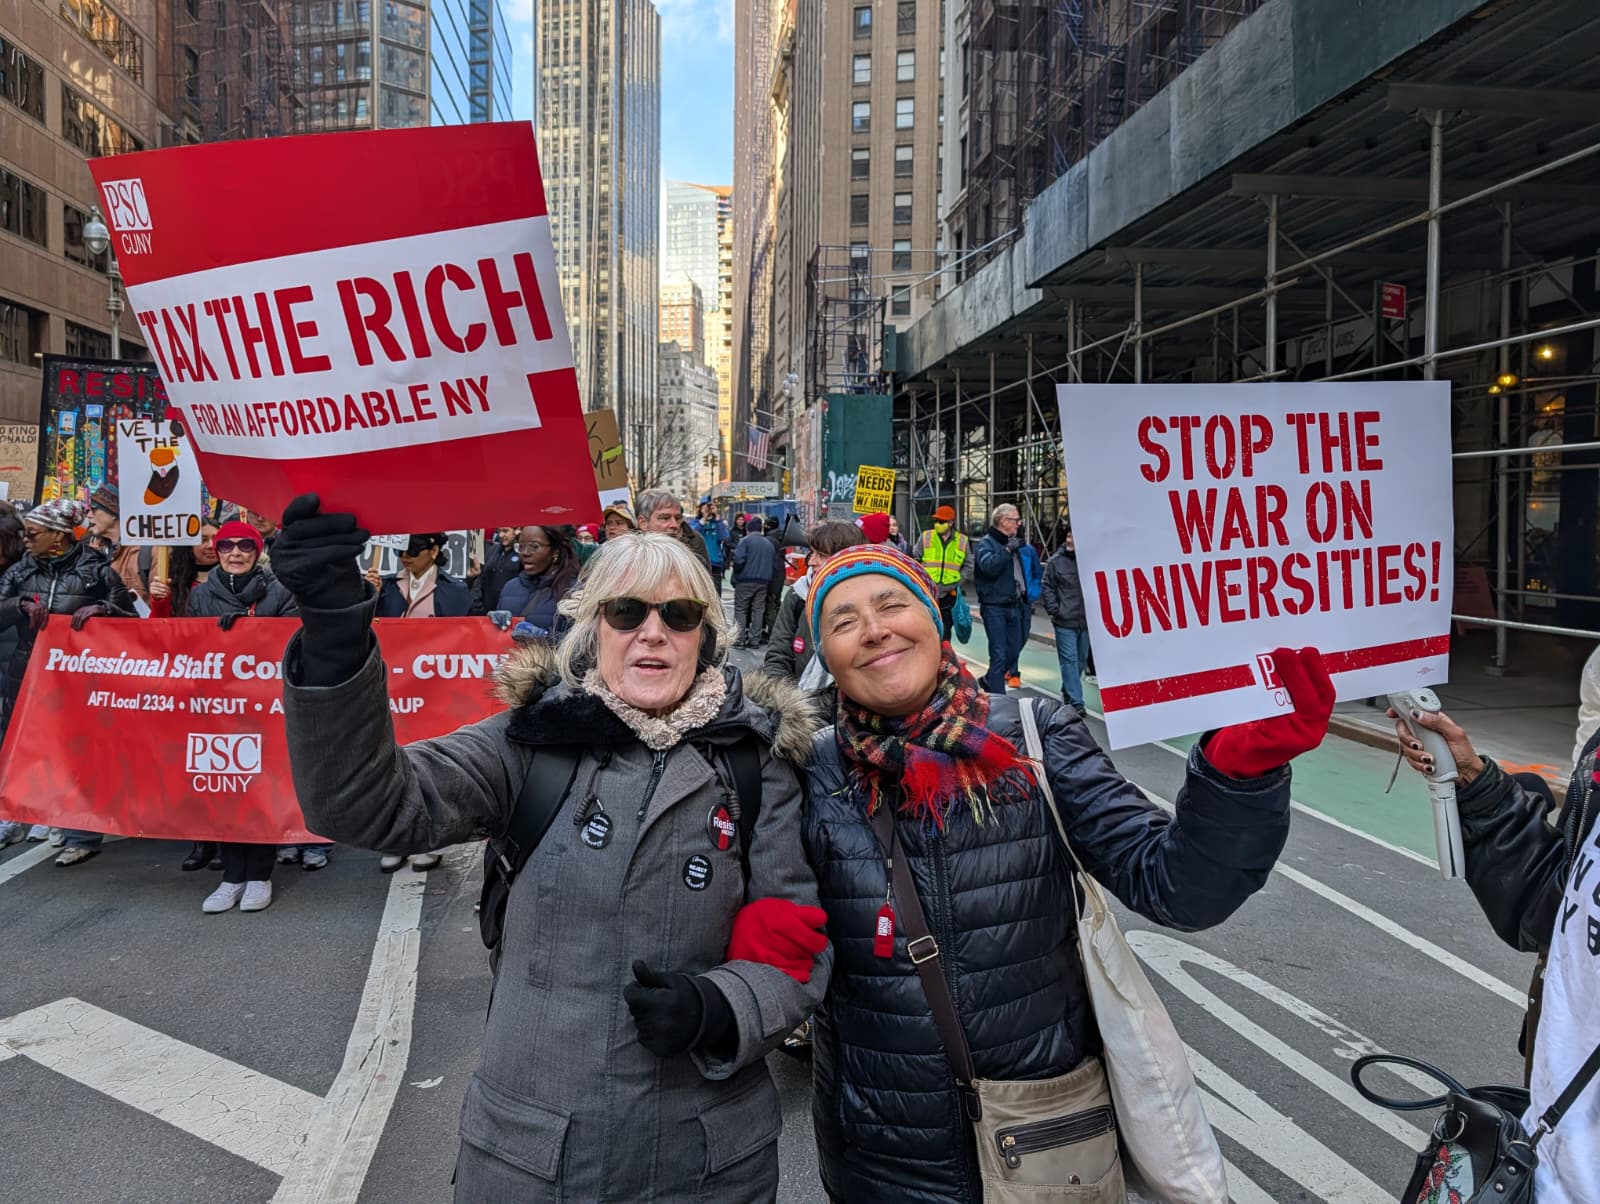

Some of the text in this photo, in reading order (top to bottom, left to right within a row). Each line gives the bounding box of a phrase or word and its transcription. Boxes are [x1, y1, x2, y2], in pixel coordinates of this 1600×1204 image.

[104, 181, 149, 227] PSC
[122, 233, 152, 254] CUNY
[138, 252, 554, 383] TAX THE RICH
[58, 369, 170, 400] RESIS
[191, 375, 490, 437] FOR AN AFFORDABLE NY
[9, 427, 37, 435] KING
[136, 437, 180, 453] THE
[1137, 411, 1384, 482] STOP THE
[858, 475, 892, 491] NEEDS
[871, 497, 889, 508] IRAN
[1168, 480, 1373, 554] WAR ON
[126, 513, 200, 539] CHEETO
[1094, 541, 1441, 638] UNIVERSITIES!
[45, 648, 169, 677] Professional
[169, 652, 225, 680] Staff
[412, 654, 510, 679] CUNY
[88, 690, 110, 706] AFT
[111, 691, 140, 710] Local
[142, 694, 174, 711] 2334
[190, 698, 247, 714] NYSUT
[188, 735, 259, 771] PSC
[193, 775, 253, 793] CUNY
